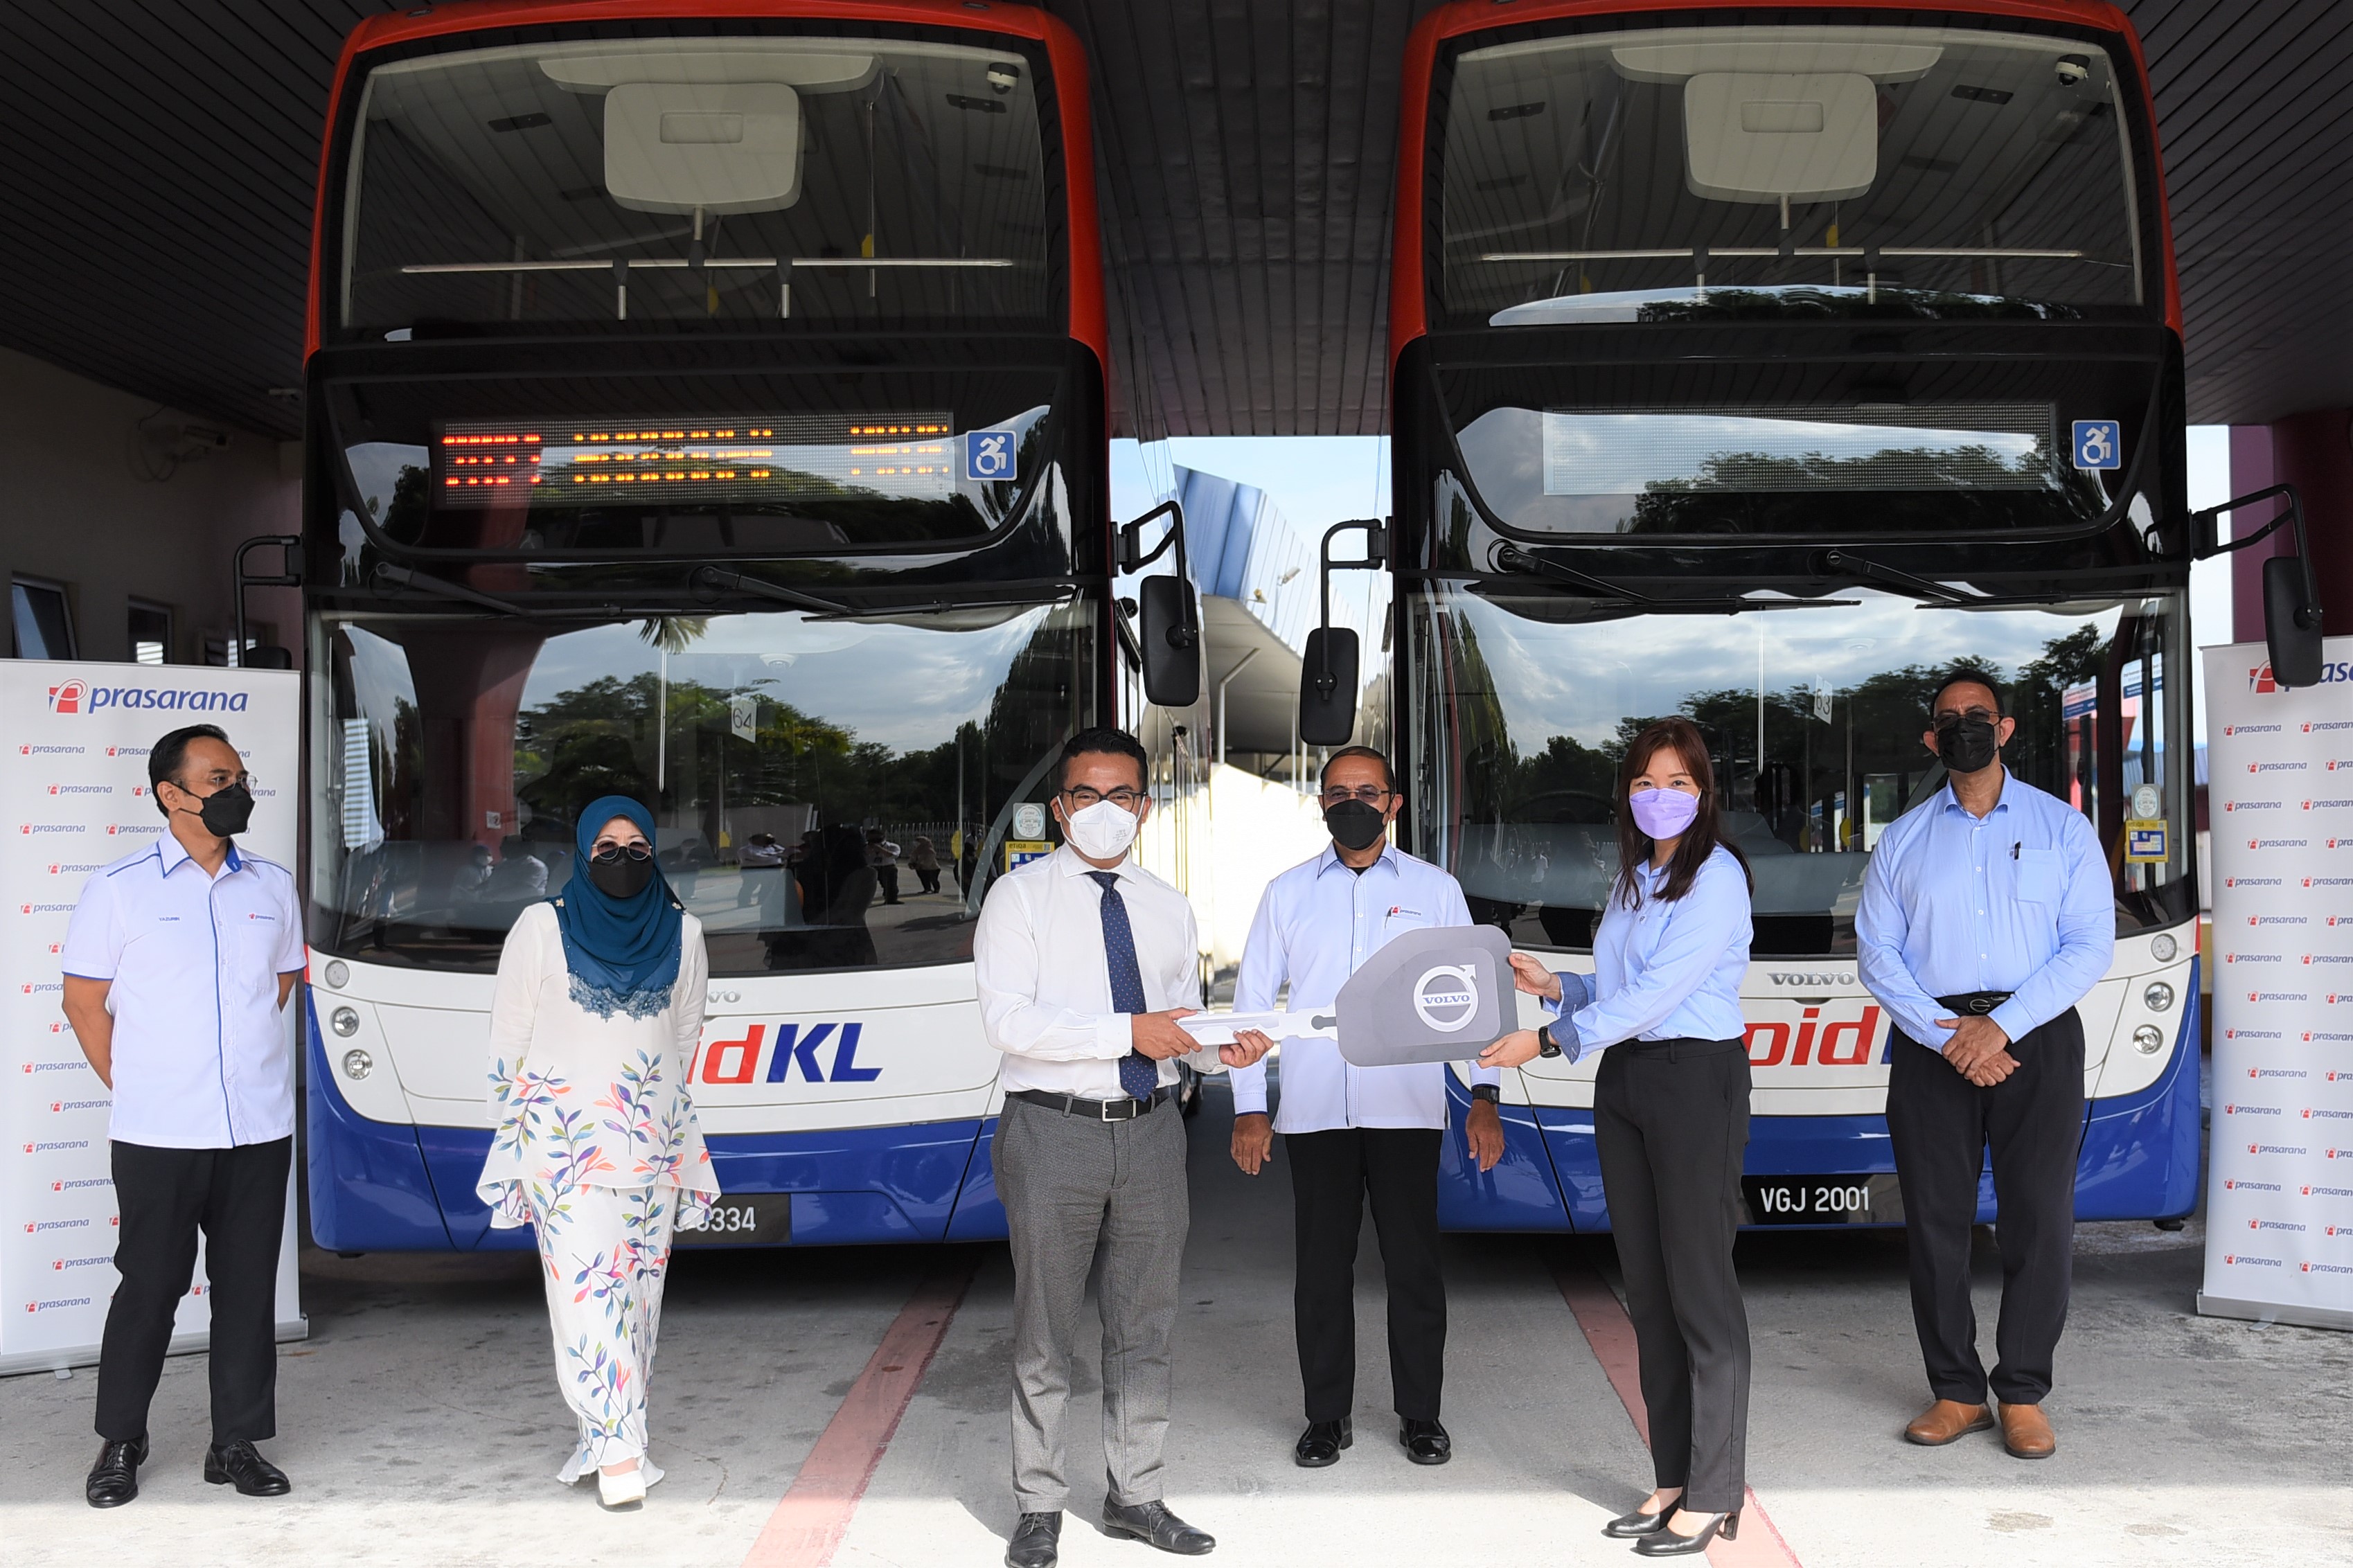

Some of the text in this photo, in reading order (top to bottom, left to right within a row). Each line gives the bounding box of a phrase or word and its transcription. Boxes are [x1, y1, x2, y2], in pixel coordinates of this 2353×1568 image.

[88, 686, 249, 714] prasarana
[1815, 688, 1830, 715] 63
[733, 708, 753, 732] 64
[2235, 724, 2282, 736] prasarana
[2313, 721, 2353, 732] prasaran
[32, 745, 85, 754] prasarana
[118, 747, 152, 756] prasar
[2259, 762, 2307, 773] prasarana
[60, 785, 112, 794] prasarana
[2235, 801, 2282, 812] prasarana
[2313, 799, 2353, 810] prasaran
[33, 825, 85, 834] prasarana
[2259, 839, 2307, 849] prasarana
[2235, 878, 2282, 888] prasarana
[2313, 877, 2353, 887] prasaran
[2259, 916, 2307, 925] prasarana
[2235, 954, 2282, 963] prasarana
[2313, 955, 2353, 964] prasaran
[1766, 972, 1856, 986] VOLVO
[34, 983, 63, 993] prasa
[1423, 995, 1471, 1004] VOLVO
[2259, 992, 2307, 1002] prasarana
[2235, 1030, 2282, 1040] prasarana
[2313, 1033, 2353, 1041] prasaran
[35, 1061, 87, 1072] prasarana
[2259, 1069, 2307, 1078] prasarana
[2235, 1105, 2281, 1115] prasarana
[2313, 1110, 2353, 1119] prasaran
[36, 1140, 88, 1152] prasarana
[2259, 1145, 2307, 1155] prasarana
[2235, 1181, 2281, 1191] prasarana
[2312, 1186, 2353, 1196] prasaran
[1760, 1186, 1870, 1213] VGJ 2001
[37, 1218, 89, 1232] prasarana
[2259, 1220, 2306, 1231] prasarana
[2235, 1256, 2282, 1267] prasarana
[2312, 1263, 2353, 1274] prasaran
[38, 1297, 90, 1311] prasarana
